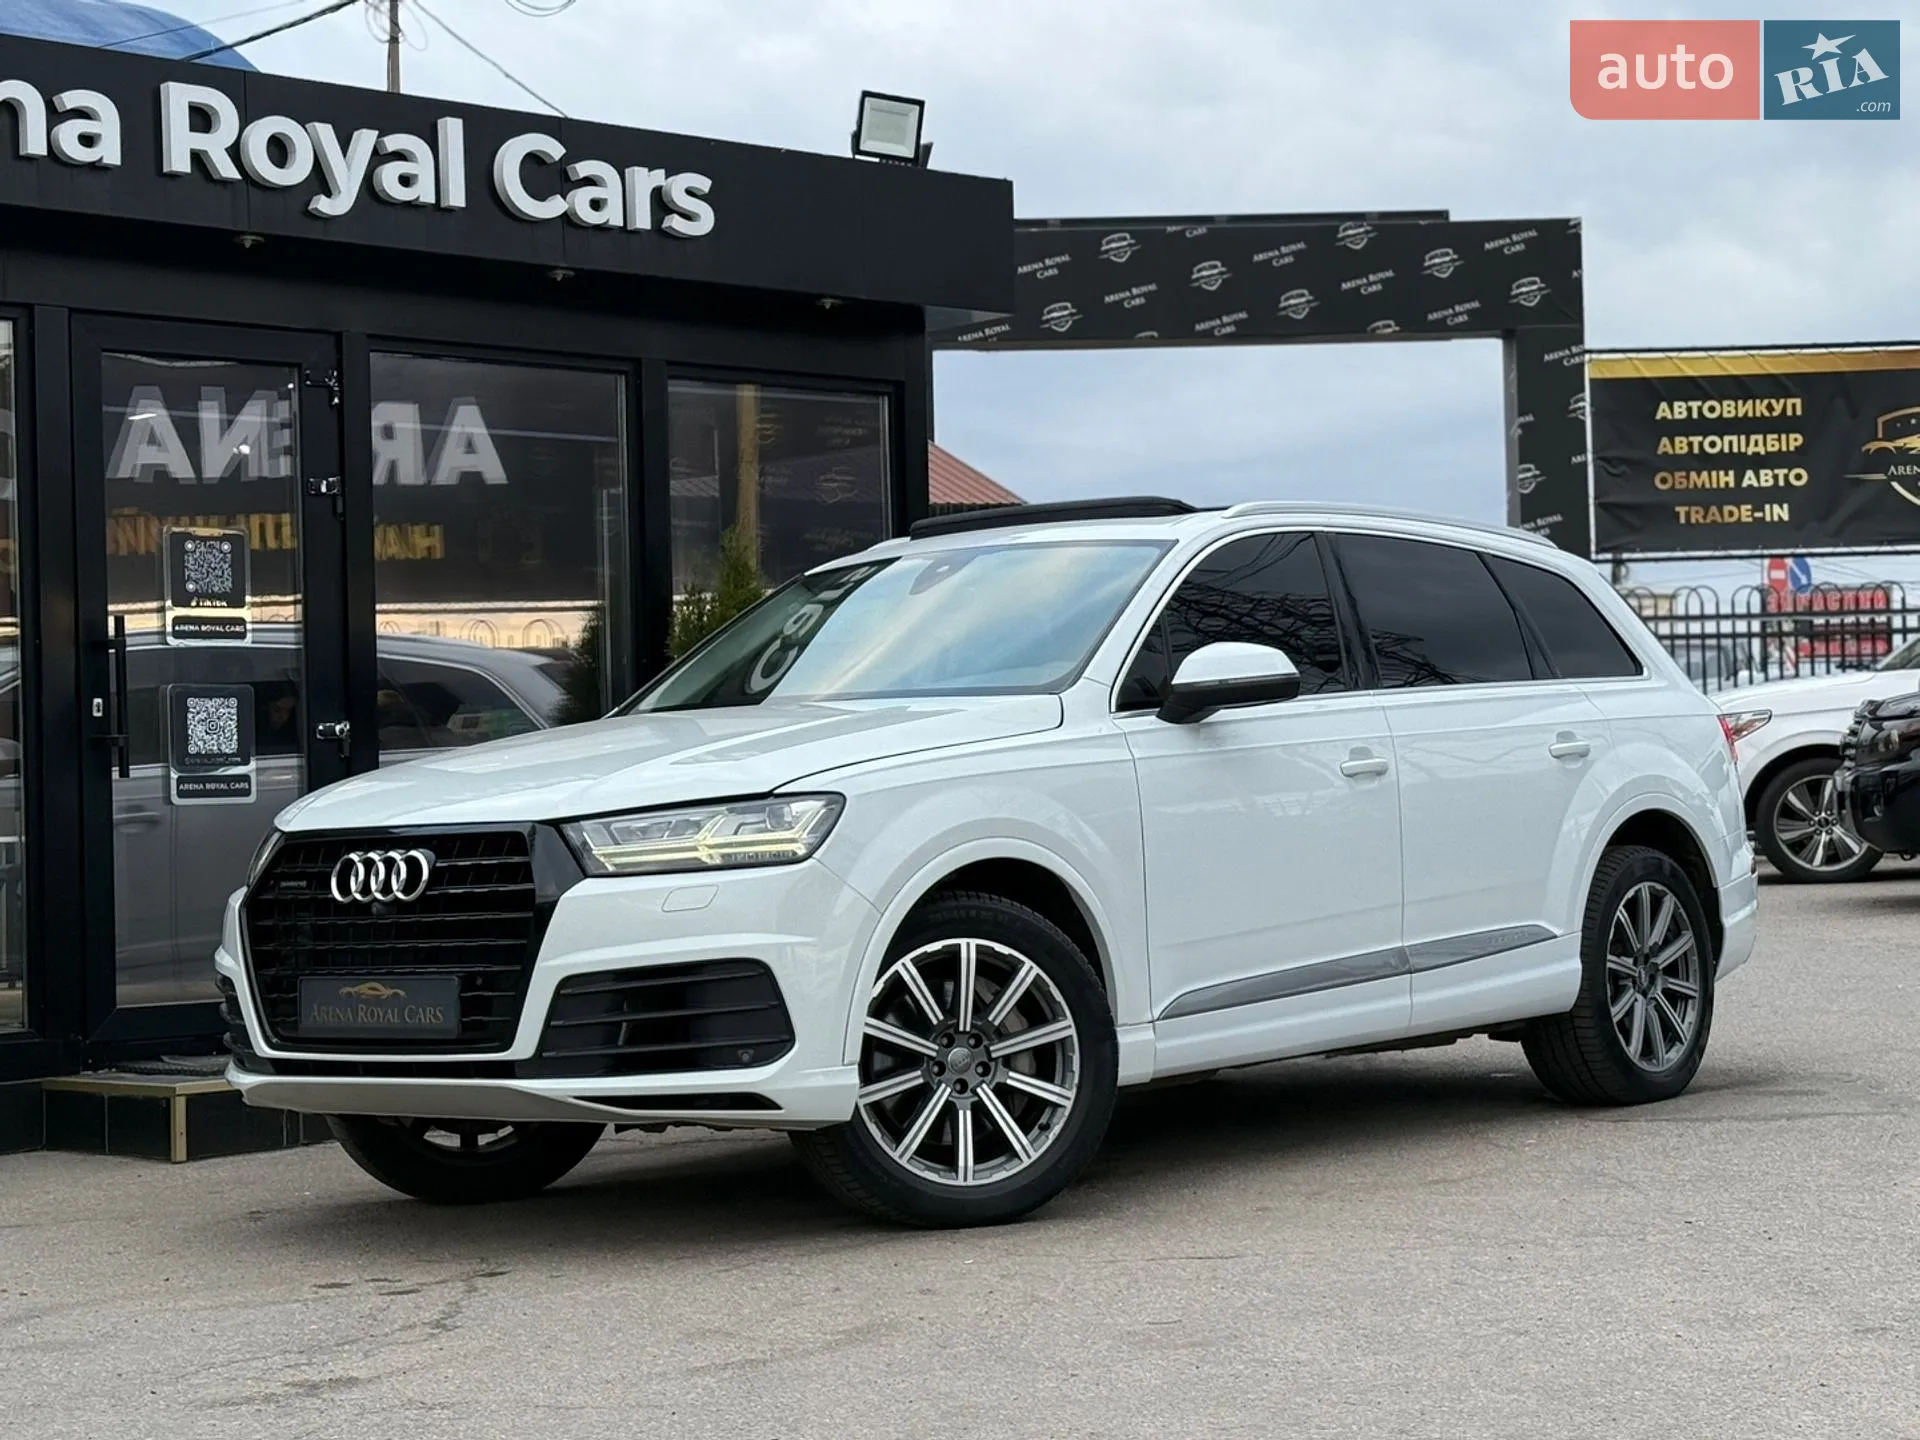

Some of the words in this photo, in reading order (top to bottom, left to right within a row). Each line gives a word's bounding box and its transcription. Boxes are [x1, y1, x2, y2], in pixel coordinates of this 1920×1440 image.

[159, 80, 467, 219] Royal
[493, 131, 717, 237] Cars
[1655, 398, 1803, 420] АВТОВИКУП
[1656, 433, 1804, 456] АВТОПІДБІР
[1654, 469, 1735, 490] ОБМІН
[1741, 467, 1808, 488] АВТО
[1675, 503, 1790, 525] TRADE-IN
[174, 623, 200, 632] ARENA
[201, 623, 224, 632] ROYAL
[225, 623, 245, 632] CARS
[179, 782, 204, 791] ARENA
[205, 782, 229, 790] ROYAL
[230, 781, 249, 790] CARS
[310, 1002, 353, 1023] ARENA
[357, 1003, 400, 1024] ROYAL
[404, 1003, 444, 1024] CARS
